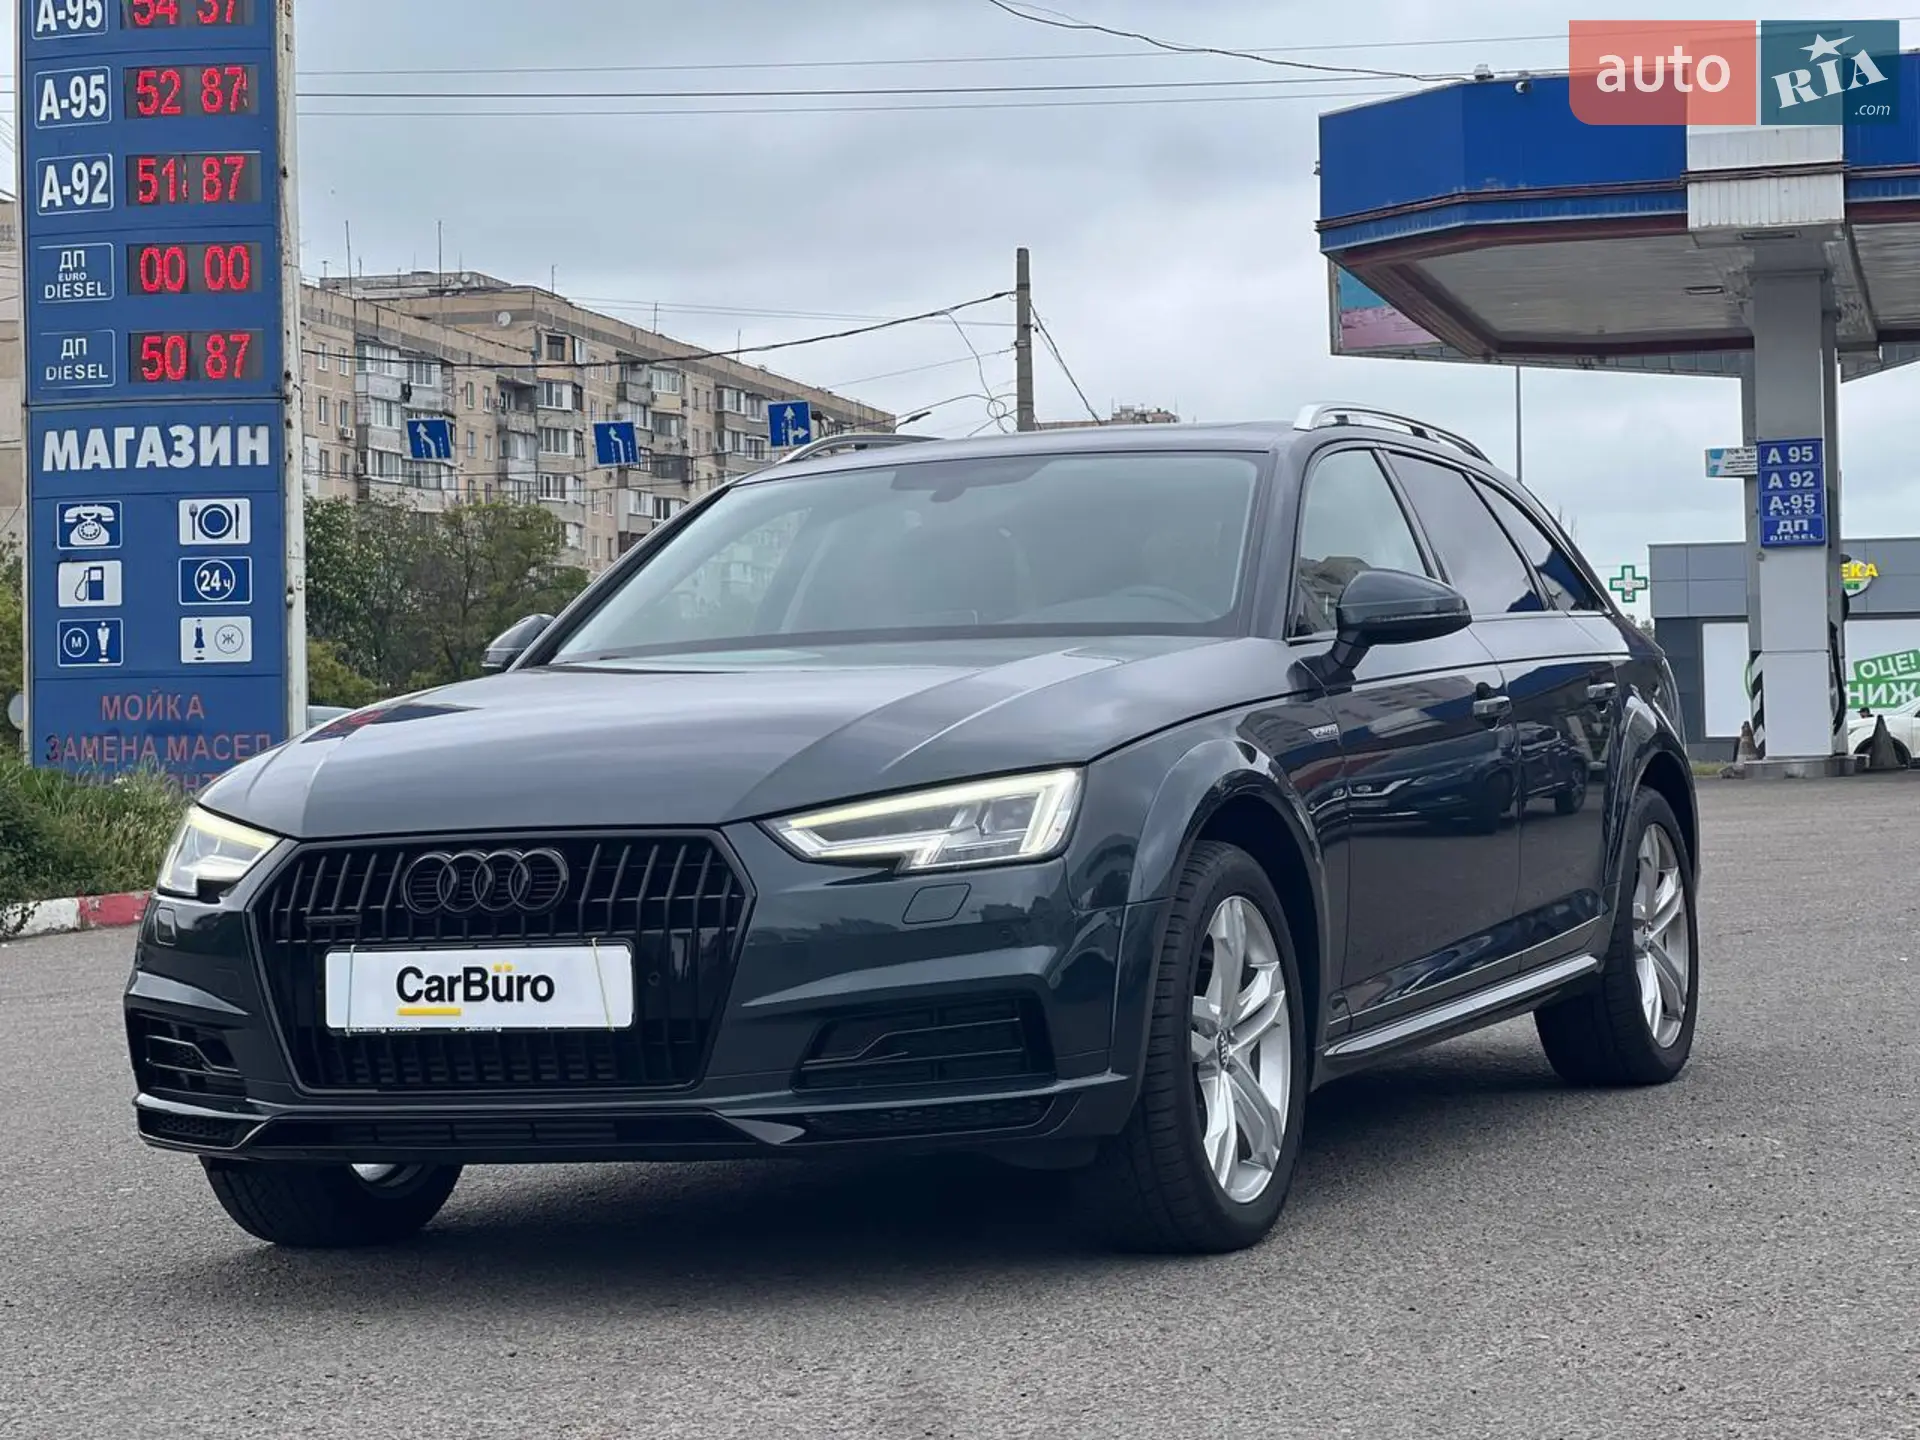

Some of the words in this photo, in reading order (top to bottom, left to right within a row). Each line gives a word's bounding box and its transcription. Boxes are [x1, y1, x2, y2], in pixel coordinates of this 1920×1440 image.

[39, 75, 106, 121] А-95
[137, 69, 182, 116] 52
[201, 67, 245, 113] 87
[41, 161, 109, 208] А-92
[138, 157, 176, 204] 51
[202, 156, 245, 203] 87
[59, 251, 85, 271] ДП
[140, 247, 186, 292] 00
[204, 245, 250, 291] 00
[58, 273, 87, 282] EURO
[45, 281, 107, 299] DIESEL
[61, 338, 87, 359] ДП
[141, 335, 187, 380] 50
[206, 333, 251, 379] 87
[46, 364, 109, 380] DIESEL
[42, 424, 270, 472] МАГАЗИН
[1788, 446, 1814, 463] 95
[1789, 471, 1815, 488] 92
[1770, 533, 1818, 541] DIESEL
[1777, 520, 1808, 535] ДП
[1860, 653, 1917, 679] ОЦЕ!
[102, 689, 205, 721] МОЙКА
[46, 735, 158, 764] ЗАМЕНА
[395, 963, 555, 1003] CarBüro
